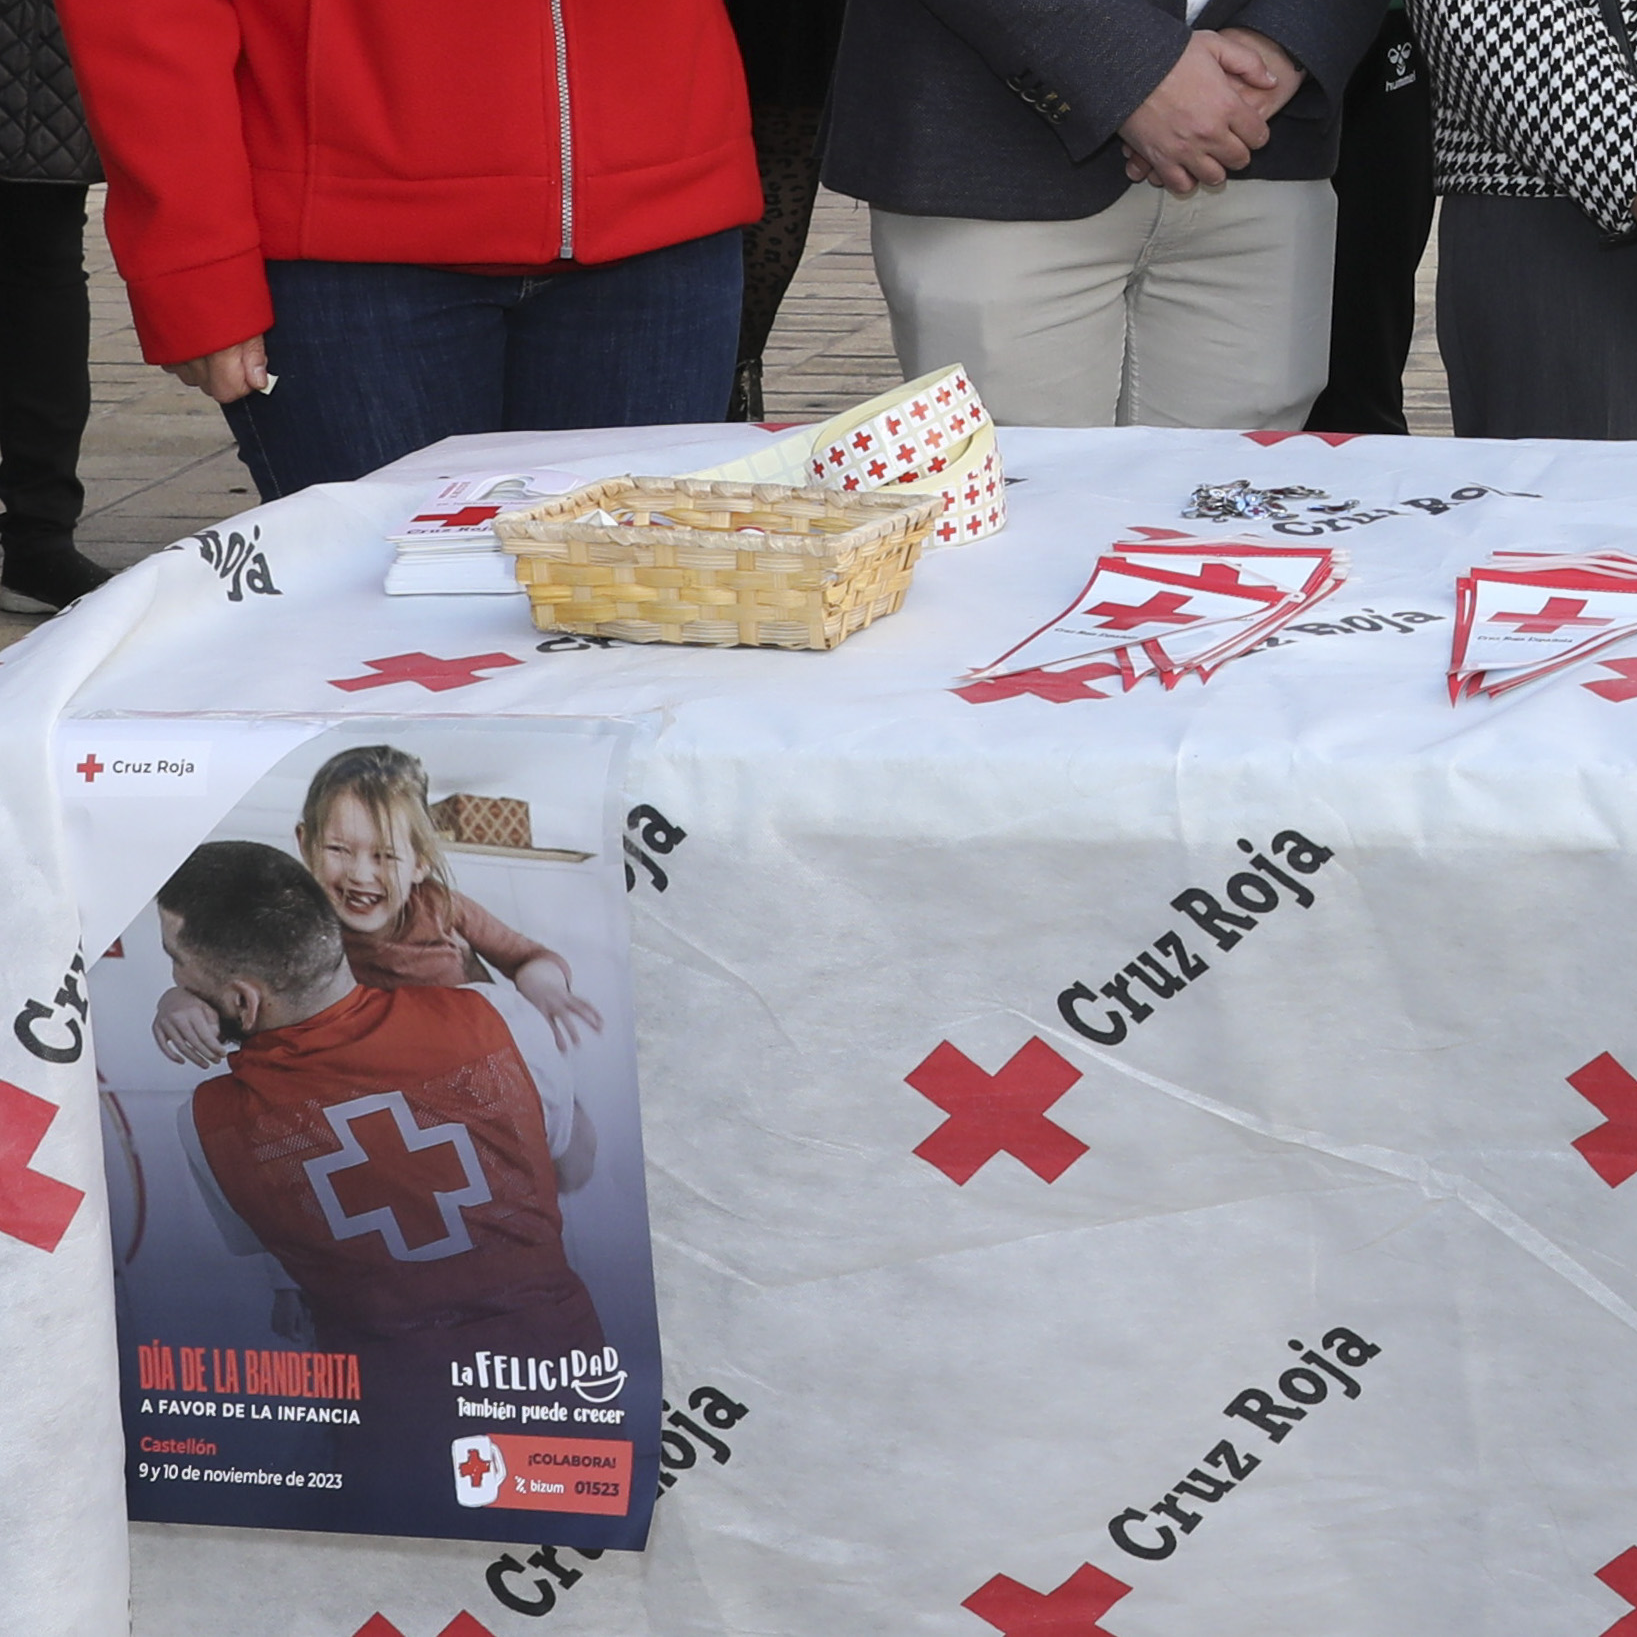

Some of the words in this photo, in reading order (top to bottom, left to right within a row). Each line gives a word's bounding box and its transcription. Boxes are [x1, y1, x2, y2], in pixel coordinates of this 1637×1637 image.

[1283, 607, 1446, 637] Roja
[112, 758, 152, 775] Cruz
[156, 757, 195, 780] Roja
[1056, 924, 1209, 1047] Cruz
[1176, 827, 1335, 974] Roja
[138, 1339, 176, 1391] DÍA
[180, 1347, 208, 1392] DE
[212, 1348, 240, 1394] LA
[244, 1349, 361, 1401] BANDERITA
[451, 1361, 473, 1387] La
[475, 1346, 620, 1392] FELICIDAD
[141, 1399, 153, 1413] A
[158, 1399, 217, 1417] FAVOR
[222, 1403, 245, 1418] DE
[251, 1404, 272, 1420] LA
[278, 1405, 361, 1425] INFANCIA
[522, 1401, 568, 1424] puede
[573, 1406, 625, 1424] crecer
[140, 1435, 217, 1456] Castellón
[1106, 1437, 1261, 1565] Cruz
[1236, 1323, 1382, 1445] Roja
[528, 1452, 617, 1469] ¡COLABORA!
[138, 1462, 148, 1478] 9
[150, 1466, 161, 1482] y
[163, 1463, 179, 1480] 10
[181, 1465, 200, 1481] de
[203, 1466, 283, 1486] noviembre
[285, 1471, 305, 1487] de
[307, 1472, 343, 1490] 2023
[530, 1479, 564, 1494] bizum
[574, 1480, 620, 1496] 01523
